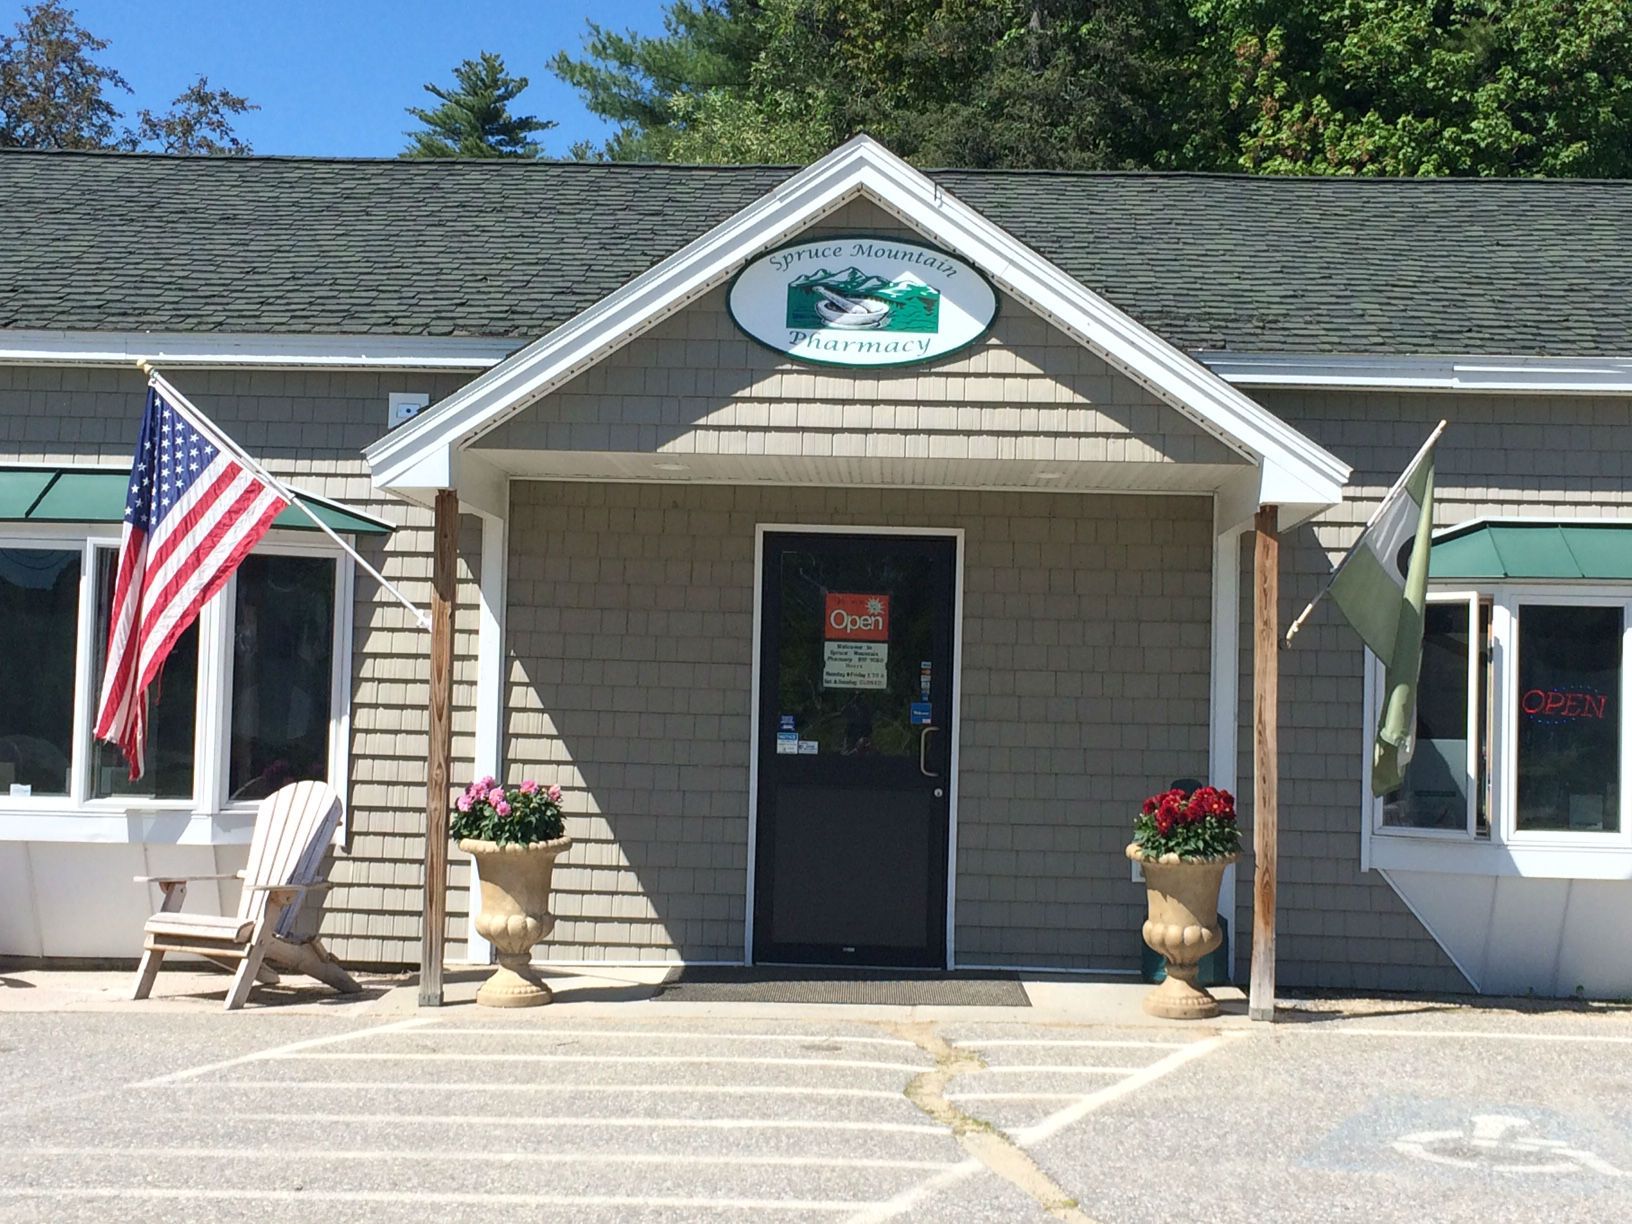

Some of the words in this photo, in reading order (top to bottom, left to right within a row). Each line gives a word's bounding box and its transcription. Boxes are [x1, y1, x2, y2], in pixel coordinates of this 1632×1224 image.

[769, 243, 842, 272] Spruce
[850, 243, 958, 279] Mountain
[789, 330, 931, 357] Pharmacy
[830, 609, 883, 633] Open
[1522, 689, 1607, 719] OPEN
